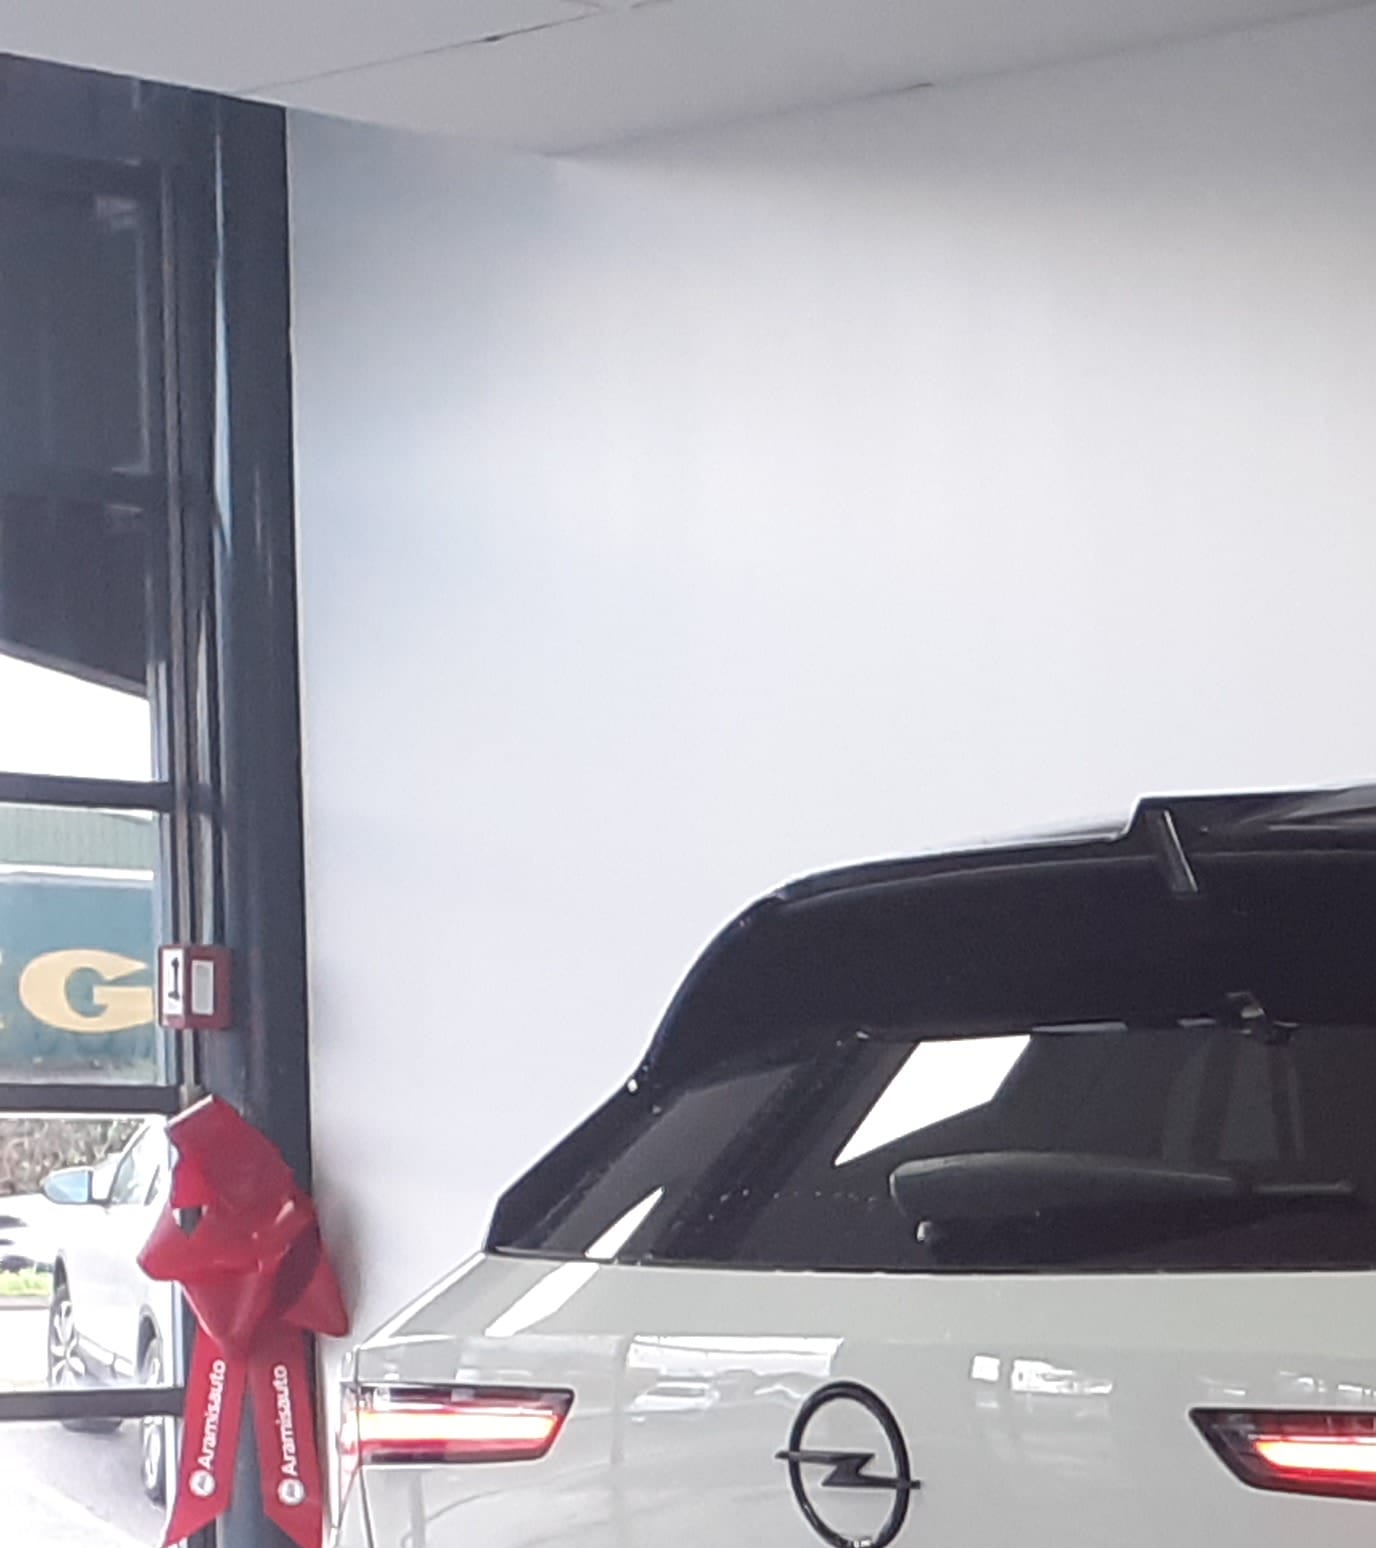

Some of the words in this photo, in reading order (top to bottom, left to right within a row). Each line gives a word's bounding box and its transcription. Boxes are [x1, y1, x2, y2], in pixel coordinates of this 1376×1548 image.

[0, 948, 154, 1034] G
[198, 1360, 226, 1469] Aramisauto
[273, 1365, 299, 1476] Aramisauto
